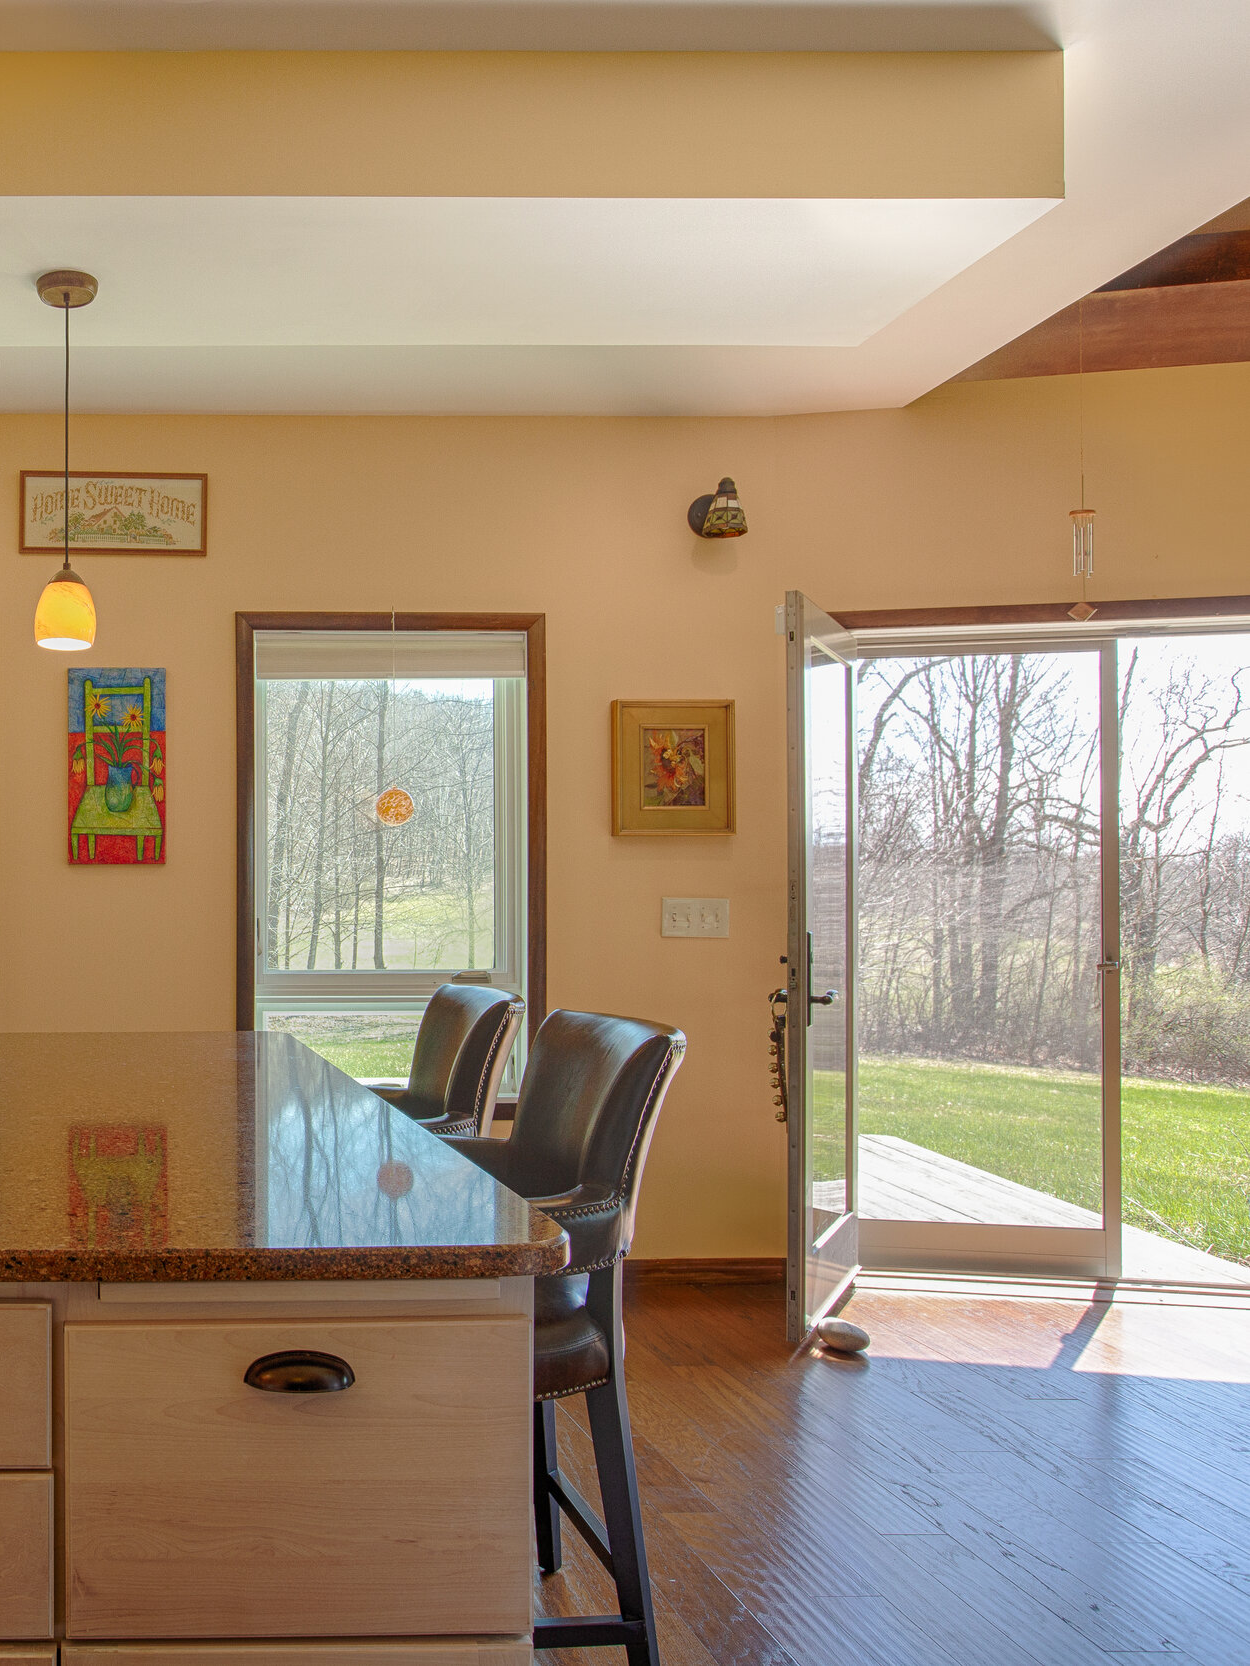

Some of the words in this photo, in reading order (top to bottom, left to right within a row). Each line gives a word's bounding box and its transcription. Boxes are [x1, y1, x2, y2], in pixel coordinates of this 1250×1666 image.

[31, 487, 82, 522] HOME
[84, 481, 147, 510] SWEET
[148, 487, 197, 526] HOME
